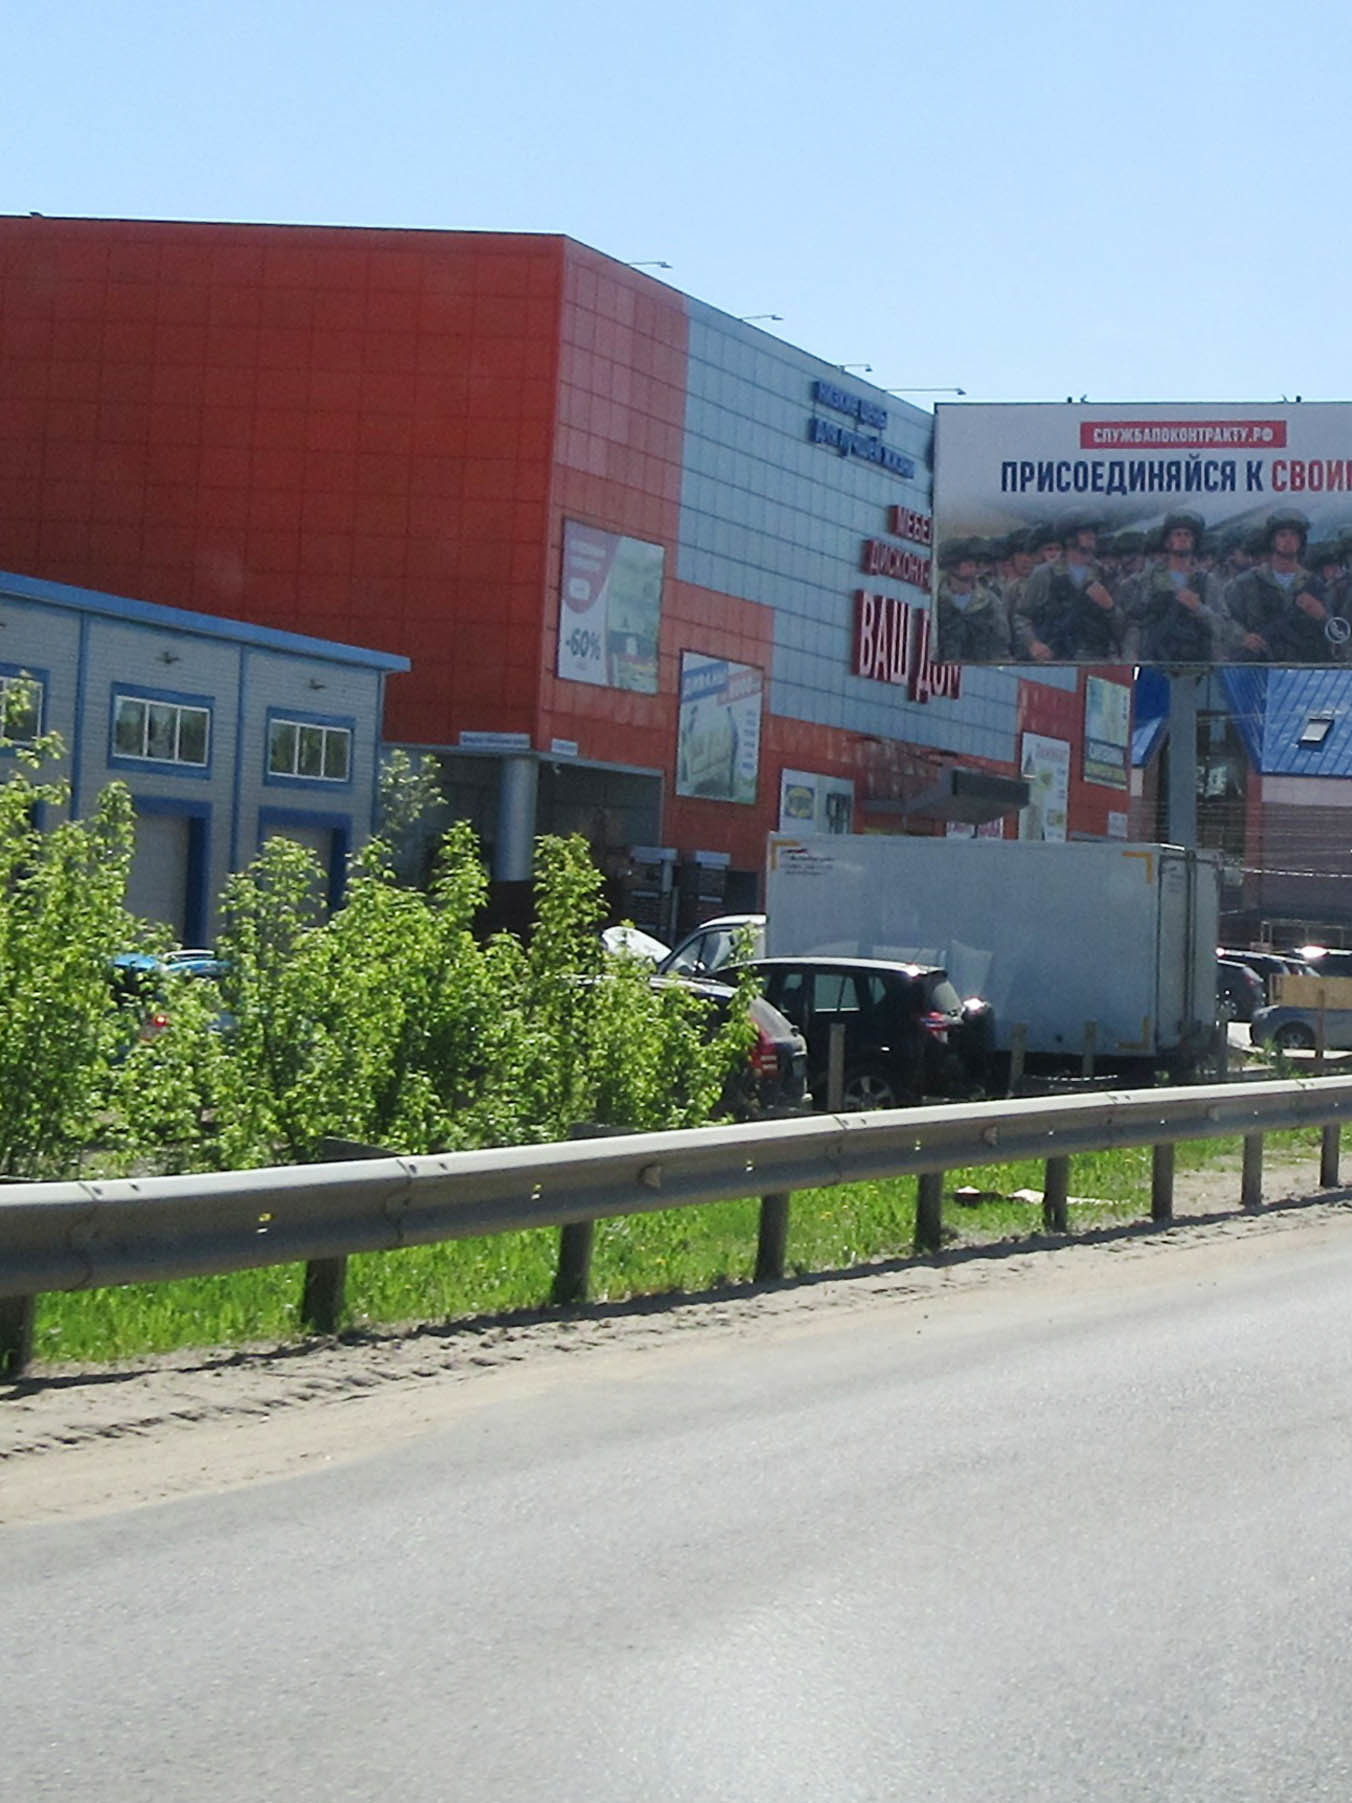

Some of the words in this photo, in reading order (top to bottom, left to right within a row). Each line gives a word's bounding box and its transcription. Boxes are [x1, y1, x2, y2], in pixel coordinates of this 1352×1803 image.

[1093, 427, 1274, 444] СЛУЖБАПОКОНТРАКТУ.РФ
[1001, 453, 1237, 496] ПРИСОЕДИНЯЙСЯ
[1246, 460, 1264, 492] К
[857, 588, 912, 685] ВАШ
